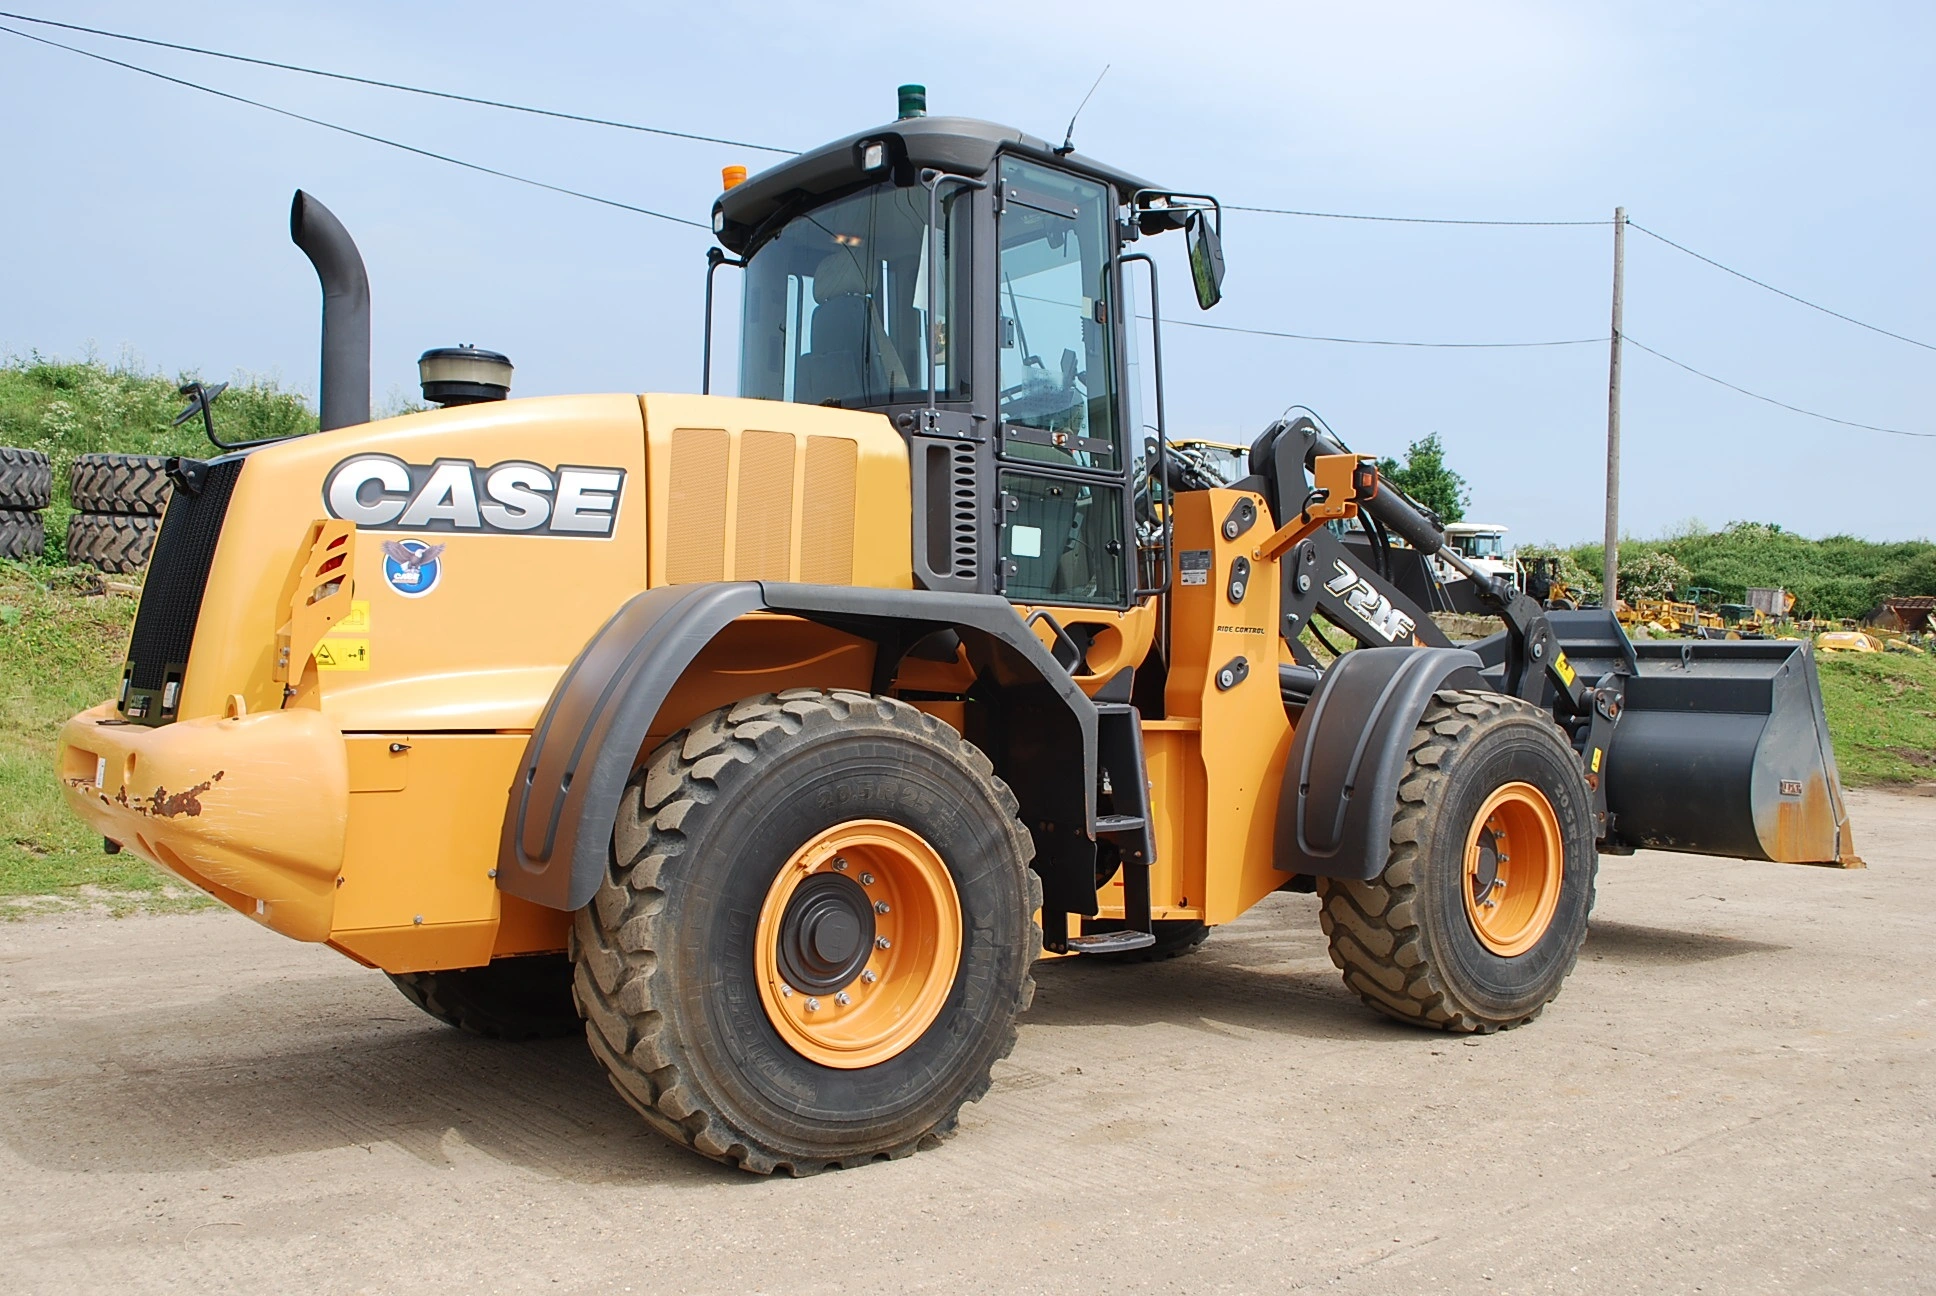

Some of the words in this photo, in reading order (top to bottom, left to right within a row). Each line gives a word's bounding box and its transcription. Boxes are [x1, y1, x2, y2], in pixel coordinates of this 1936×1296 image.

[327, 457, 623, 533] CASE
[1217, 625, 1233, 633] RIDE
[1235, 626, 1265, 635] CONTROL
[1324, 557, 1416, 642] 721F
